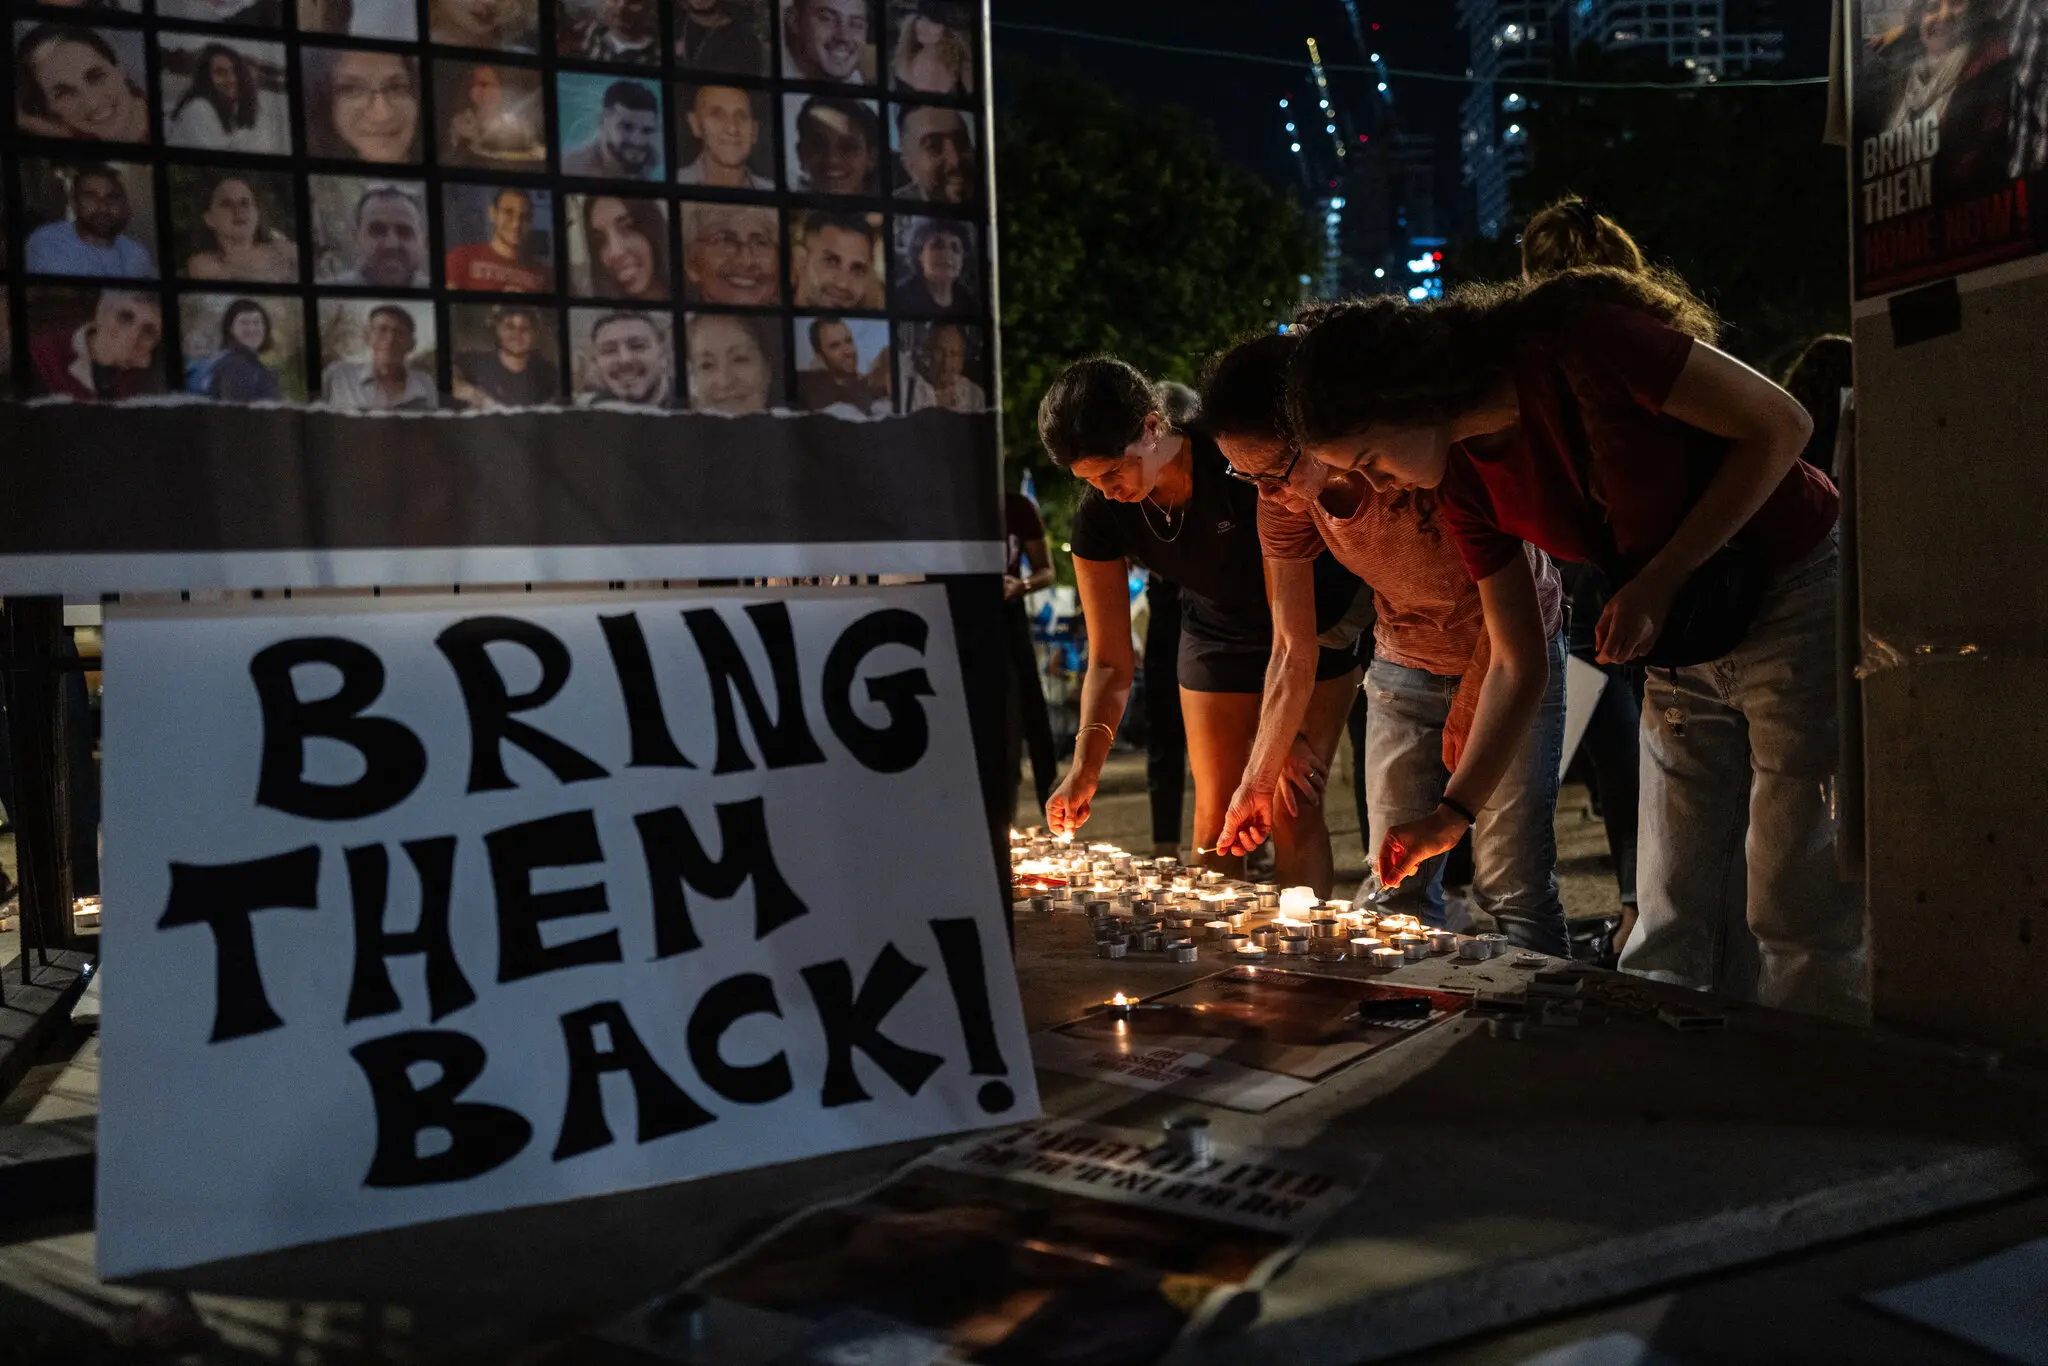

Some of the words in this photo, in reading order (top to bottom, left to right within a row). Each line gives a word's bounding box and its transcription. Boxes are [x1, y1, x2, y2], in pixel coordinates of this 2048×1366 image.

[1862, 164, 1932, 224] THEM
[1863, 114, 1940, 180] BRING
[249, 600, 937, 822] BRING
[156, 795, 810, 1044] THEM
[349, 916, 1016, 1189] BACK!
